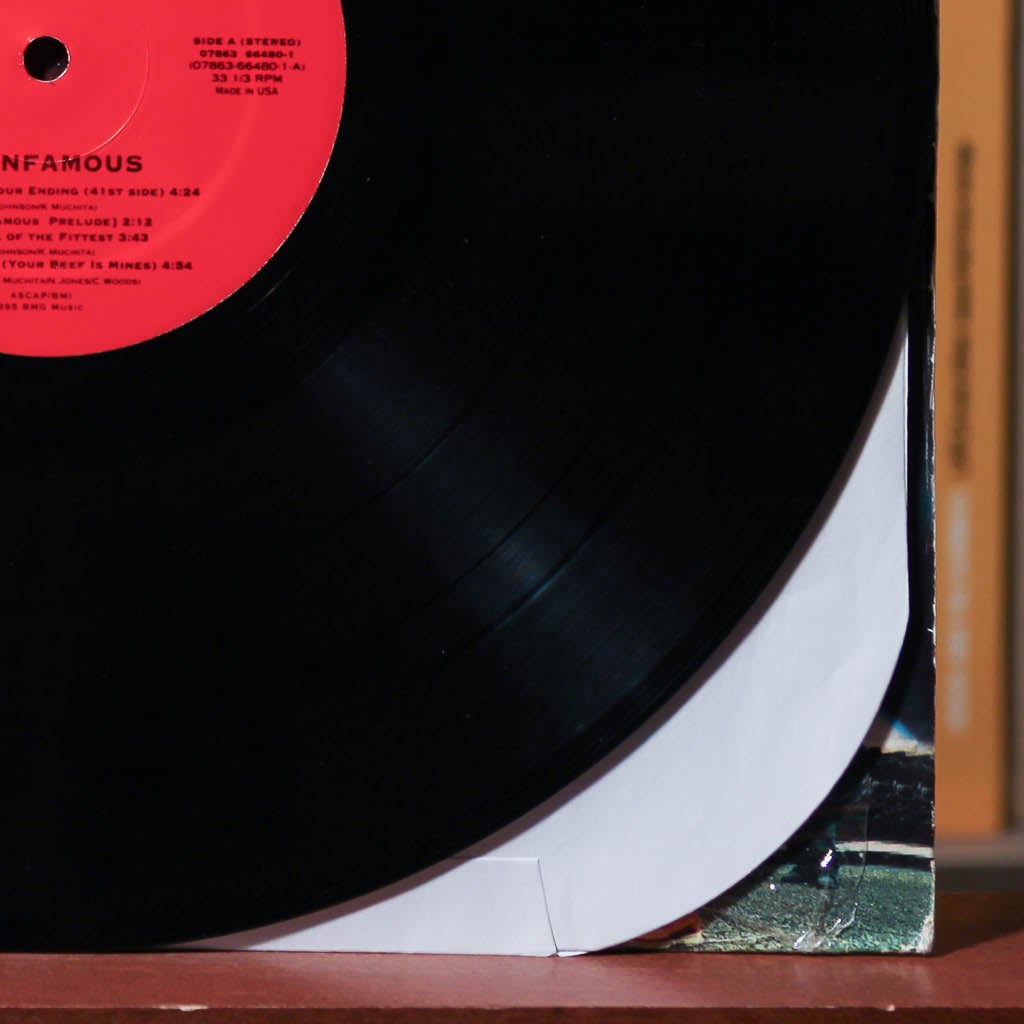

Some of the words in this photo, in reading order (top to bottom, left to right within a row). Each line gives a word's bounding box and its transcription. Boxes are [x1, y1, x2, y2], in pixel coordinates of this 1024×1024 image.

[193, 37, 223, 45] SIDE
[228, 37, 236, 45] A
[240, 38, 302, 47] (STEREO)
[199, 49, 237, 58] 07863
[245, 50, 294, 58] 66480-1
[212, 74, 227, 82] 33
[255, 74, 283, 83] RPM
[256, 87, 278, 95] USA
[169, 188, 200, 197] 4:24
[122, 217, 153, 227] 2:12
[119, 233, 149, 242] 3:43
[162, 261, 193, 270] 4:54
